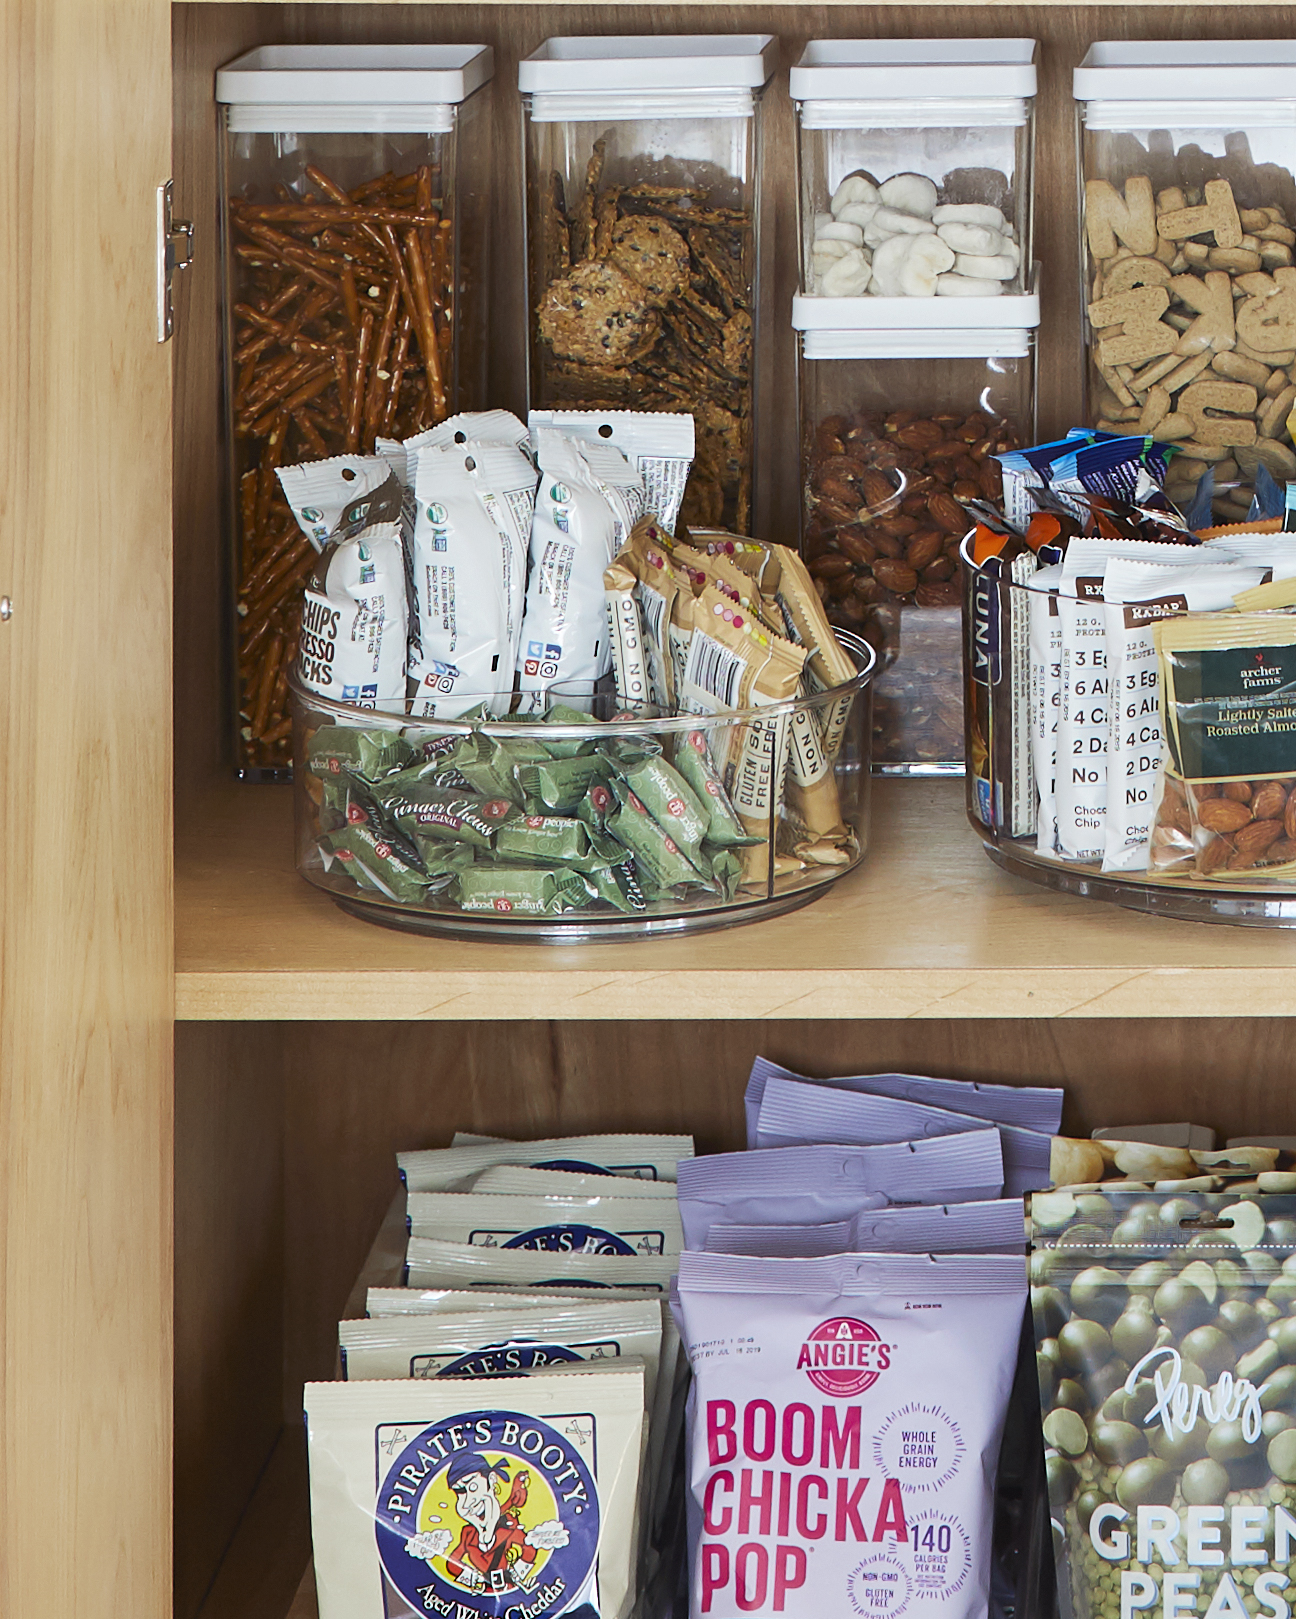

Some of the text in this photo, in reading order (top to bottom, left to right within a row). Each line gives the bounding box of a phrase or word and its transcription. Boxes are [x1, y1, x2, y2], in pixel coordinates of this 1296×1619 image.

[975, 573, 989, 668] LUNA
[622, 598, 643, 711] GMO NON
[1075, 651, 1085, 666] 3
[1240, 665, 1283, 678] archer
[1074, 682, 1086, 696] 6
[1126, 674, 1137, 690] 3
[1243, 676, 1282, 690] farms
[1074, 709, 1086, 725] 4
[1126, 702, 1137, 718] 6
[1217, 708, 1264, 722] Lightly
[1206, 723, 1260, 738] Roasted
[1126, 731, 1137, 747] 4
[801, 734, 818, 775] NON
[1073, 740, 1083, 755] 2
[1072, 768, 1099, 784] No
[1126, 761, 1136, 776] 2
[740, 758, 757, 805] GLUTEN
[756, 764, 770, 808] FREE
[1126, 788, 1148, 804] No
[420, 812, 458, 828] ORIGINAL
[1075, 817, 1100, 828] Chip
[796, 1344, 891, 1371] ANGIE'S
[706, 1398, 862, 1470] BOOM
[902, 1431, 937, 1443] WHOLE
[903, 1444, 934, 1456] GRAIN
[388, 1419, 587, 1514] PIRATE'S BOOTY
[899, 1456, 938, 1468] ENERGY
[702, 1468, 909, 1543] CHICKA
[911, 1524, 951, 1553] 140
[914, 1554, 949, 1564] CALORIES
[915, 1563, 946, 1573] PER BAG
[701, 1542, 807, 1613] POP
[417, 1576, 566, 1619] Aged Cheddar
[865, 1588, 894, 1599] GLUTEN
[1120, 1570, 1292, 1619] PEAS
[870, 1597, 888, 1608] FREE
